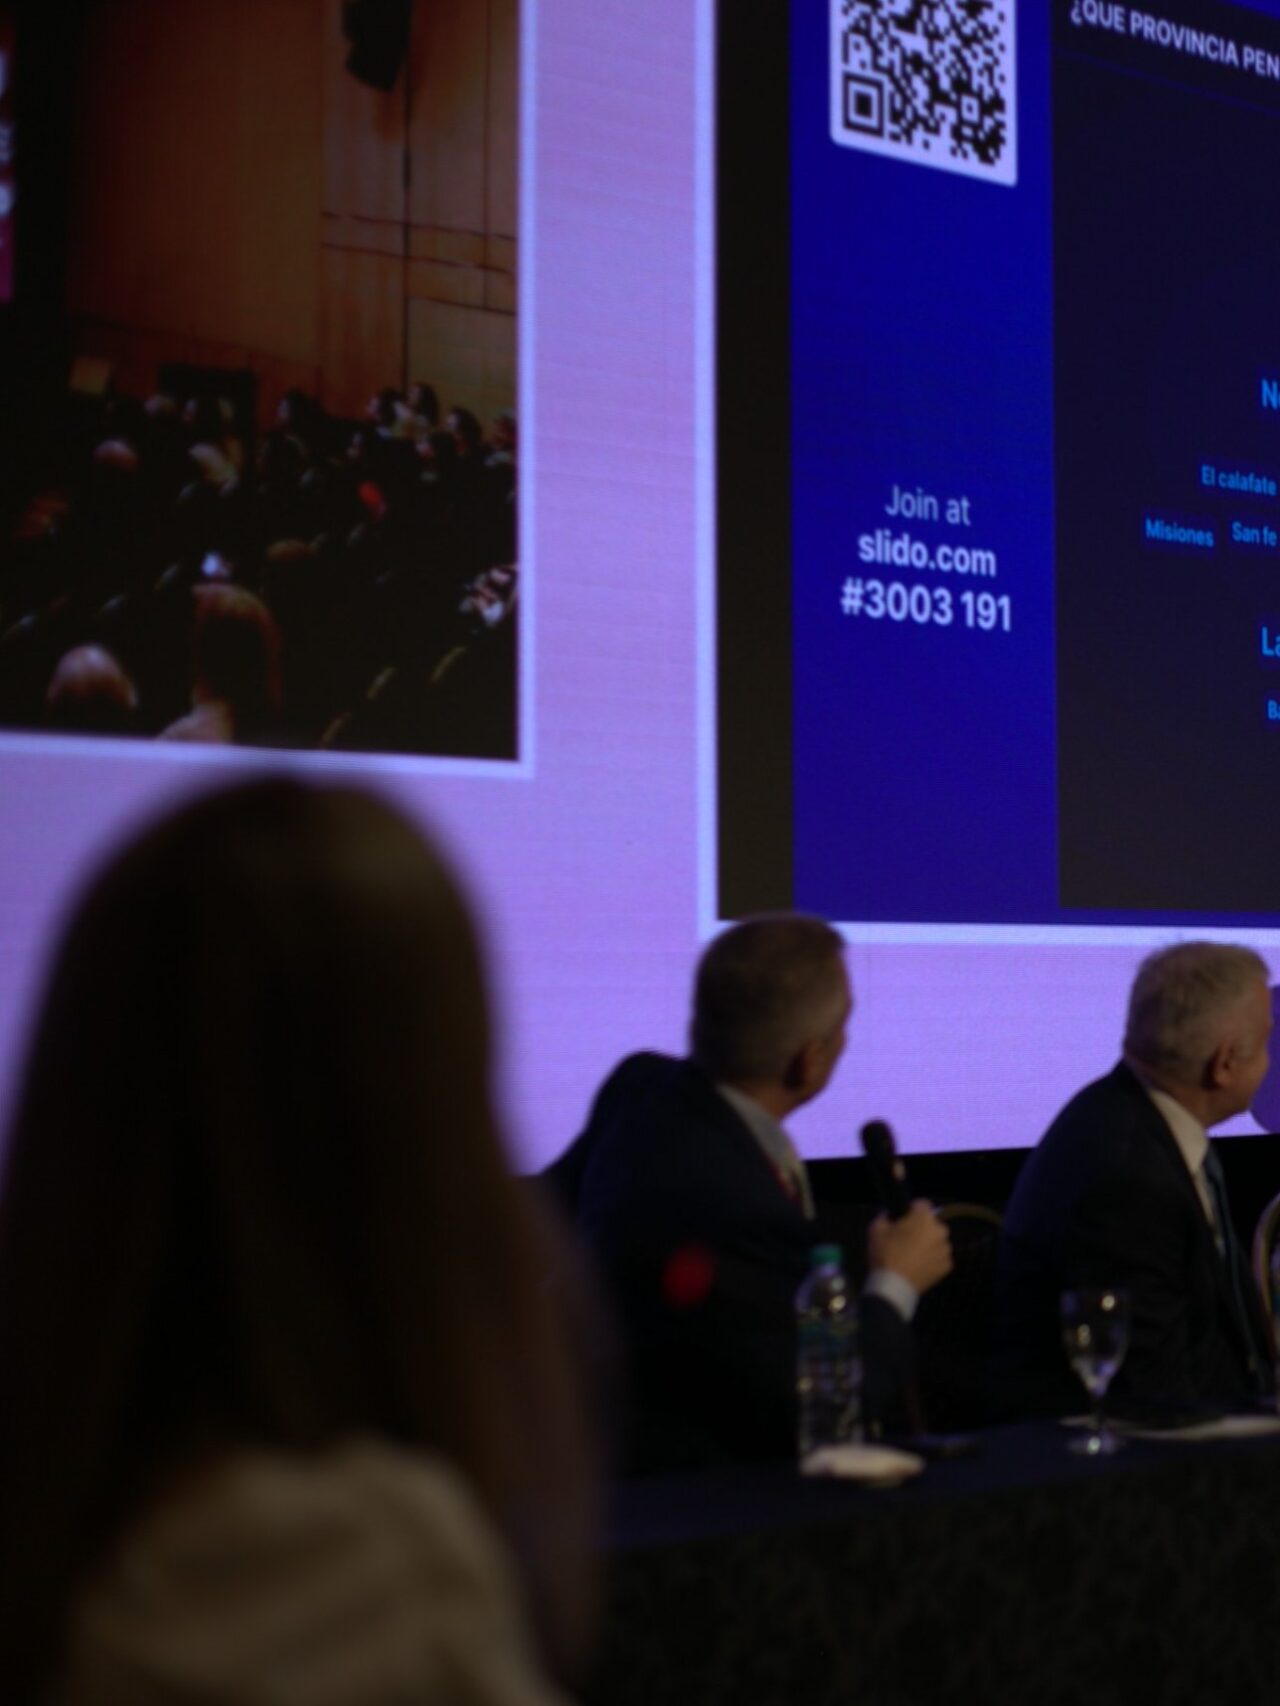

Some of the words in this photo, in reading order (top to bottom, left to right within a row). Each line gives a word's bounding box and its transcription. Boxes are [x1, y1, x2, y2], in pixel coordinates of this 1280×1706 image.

[1129, 10, 1239, 68] PROVINCIA
[1201, 464, 1215, 487] El
[1217, 469, 1278, 497] calafate
[884, 483, 939, 522] Join
[945, 495, 971, 527] at
[857, 527, 997, 578] slido.com
[1145, 516, 1215, 548] Misiones
[1231, 520, 1260, 545] San
[1263, 525, 1278, 547] fe
[840, 575, 953, 626] #3003
[959, 589, 1012, 632] 191
